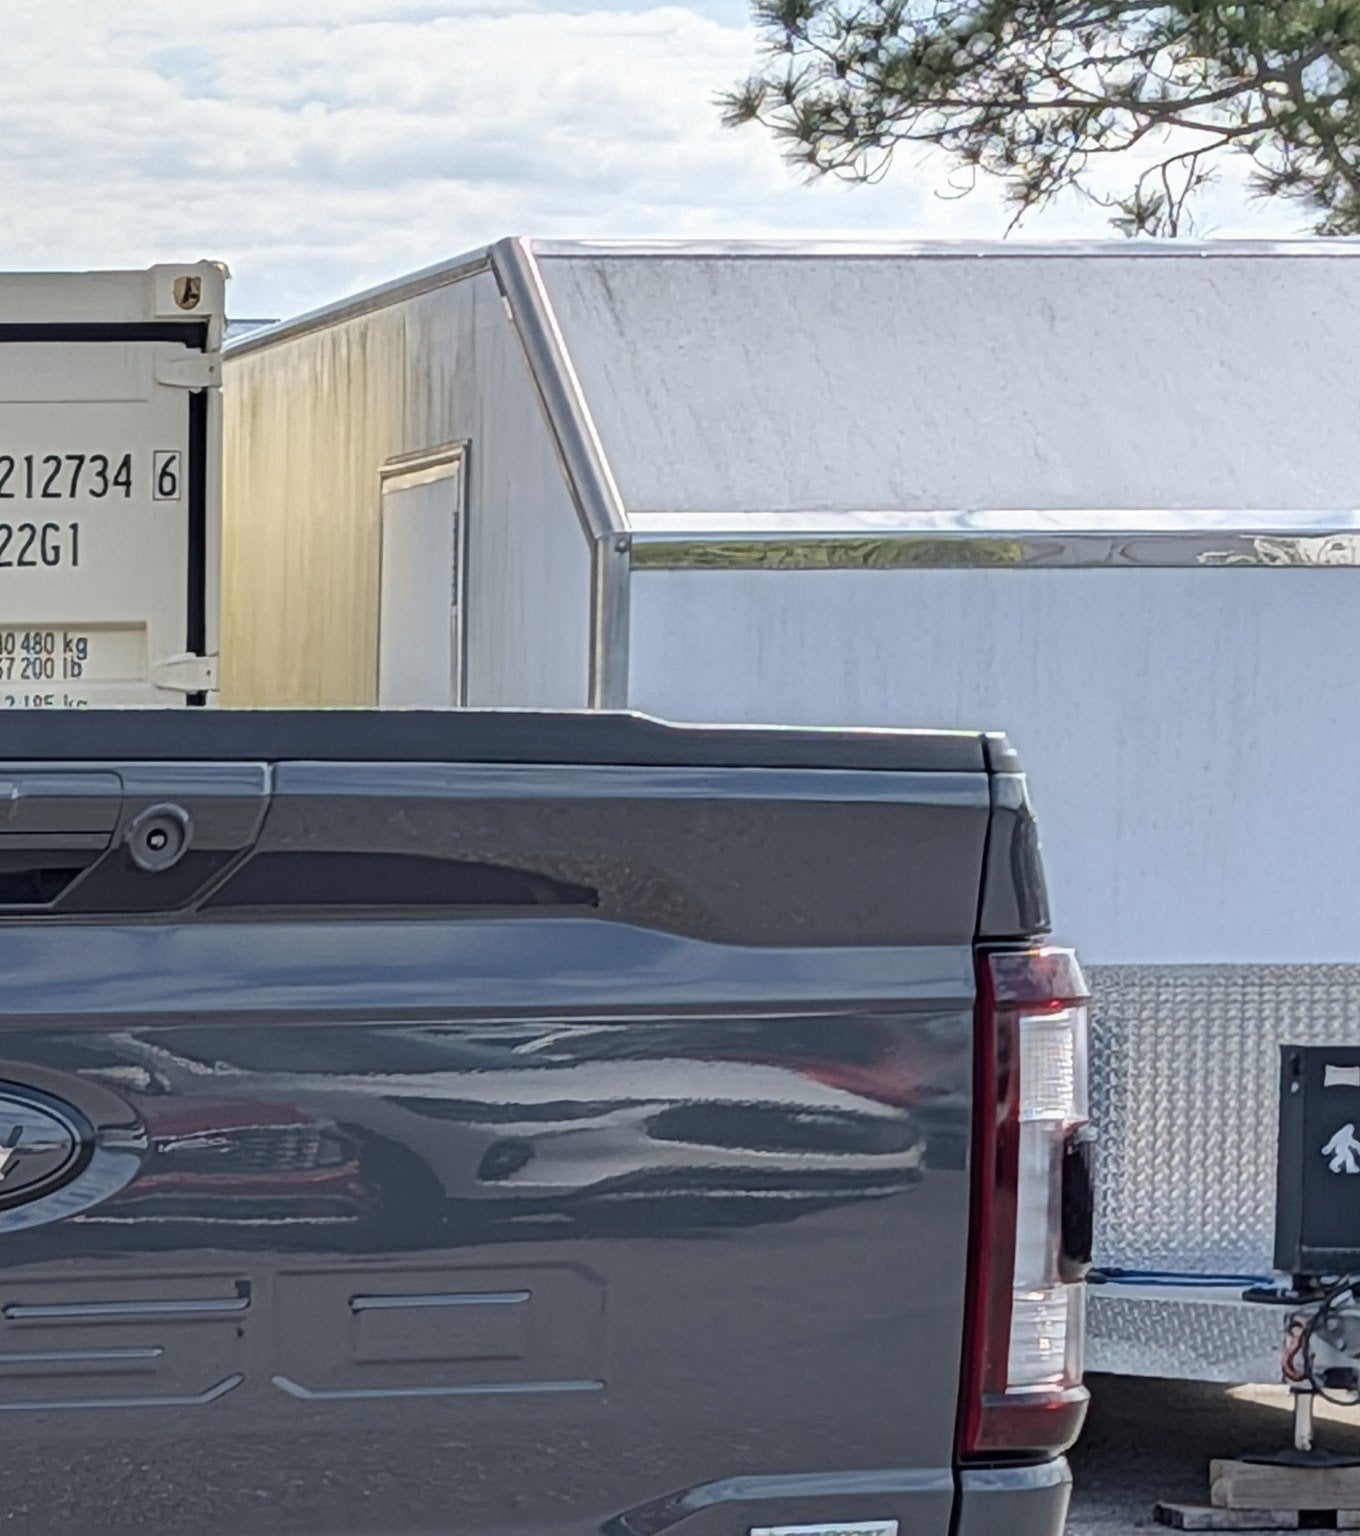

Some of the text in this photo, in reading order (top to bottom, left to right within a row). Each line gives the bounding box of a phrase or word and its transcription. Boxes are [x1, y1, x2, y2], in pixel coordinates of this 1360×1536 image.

[158, 454, 177, 497] 6
[63, 632, 88, 661] kg
[63, 657, 83, 680] lb
